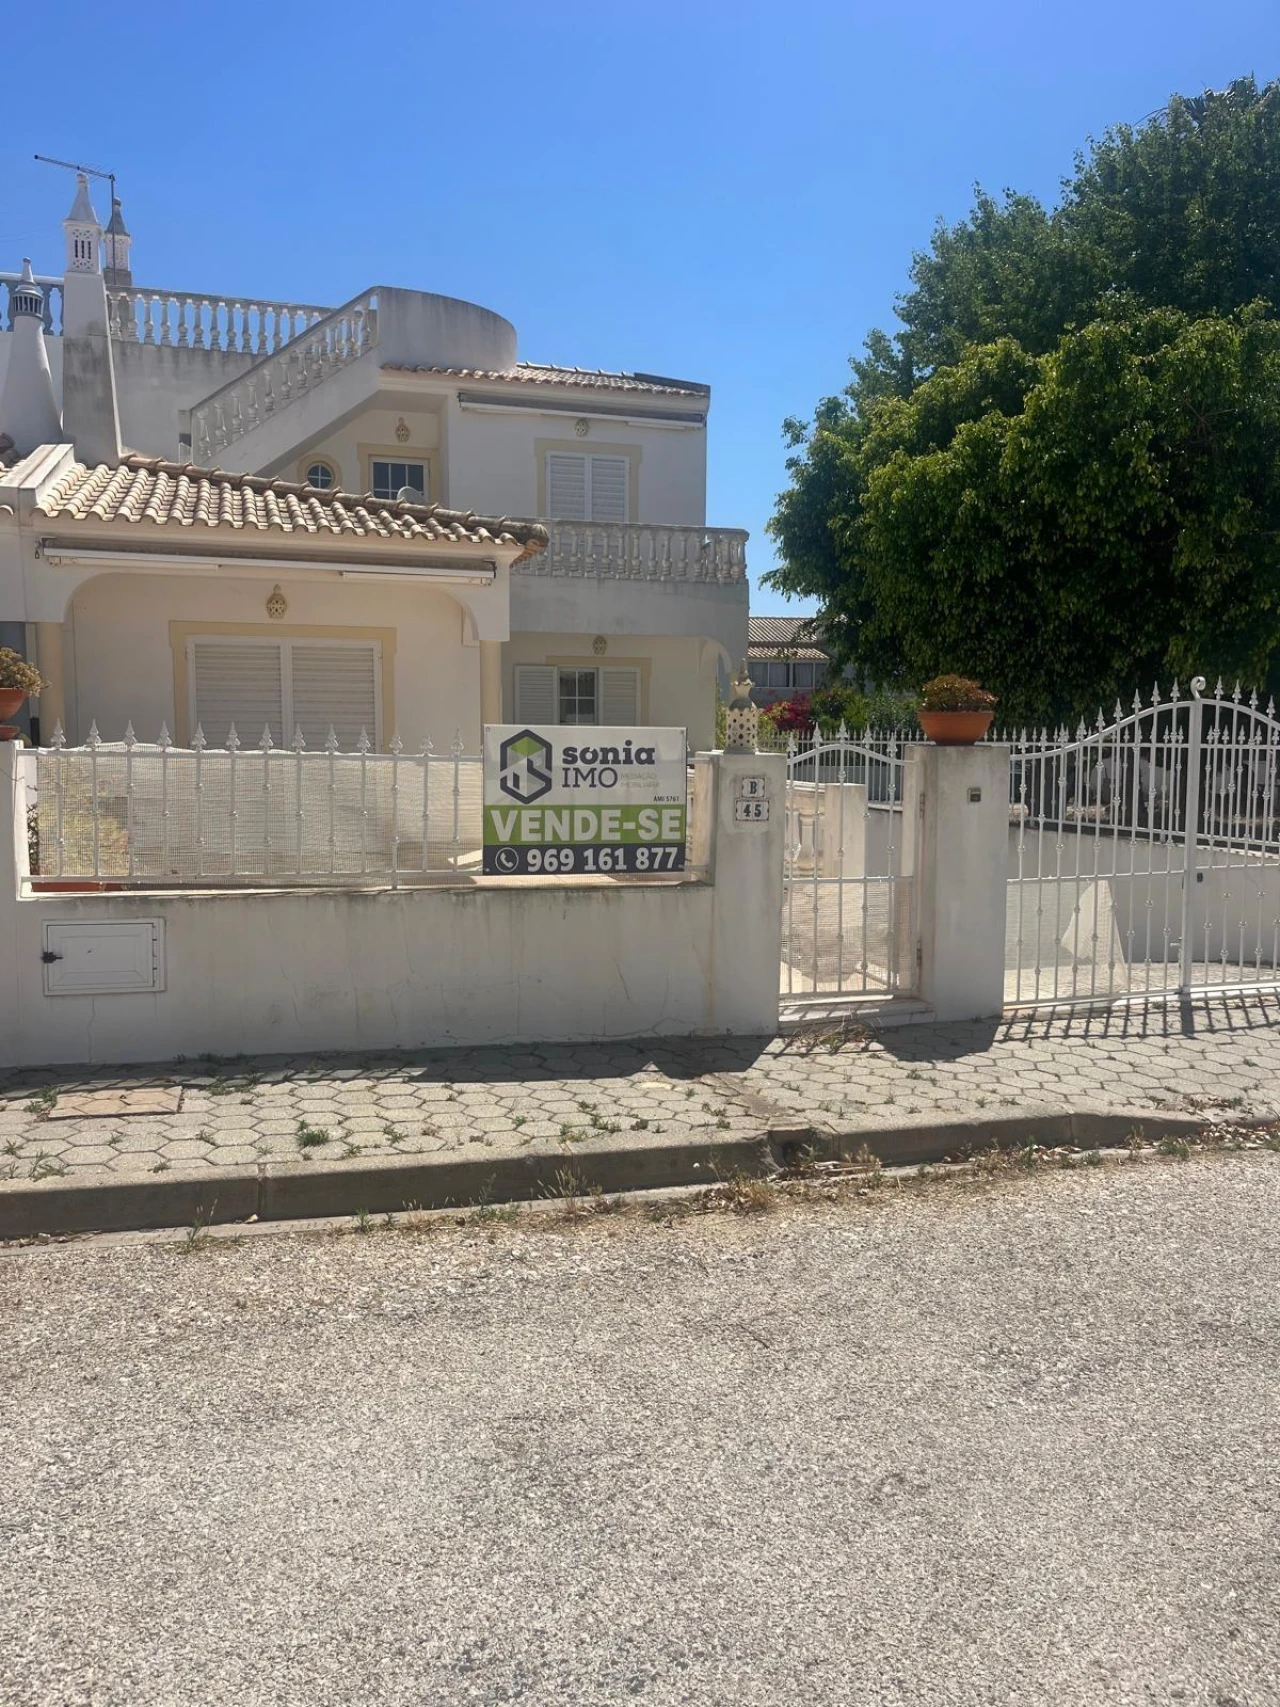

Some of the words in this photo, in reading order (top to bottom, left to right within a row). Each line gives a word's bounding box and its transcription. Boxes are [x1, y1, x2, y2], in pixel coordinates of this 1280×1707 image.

[562, 739, 656, 765] sonia
[562, 767, 618, 788] IMO
[750, 781, 757, 794] B
[743, 804, 761, 817] 45
[490, 808, 682, 842] VENDE-SE
[526, 848, 575, 872] 969
[583, 848, 627, 871] 161
[635, 847, 678, 870] 877
